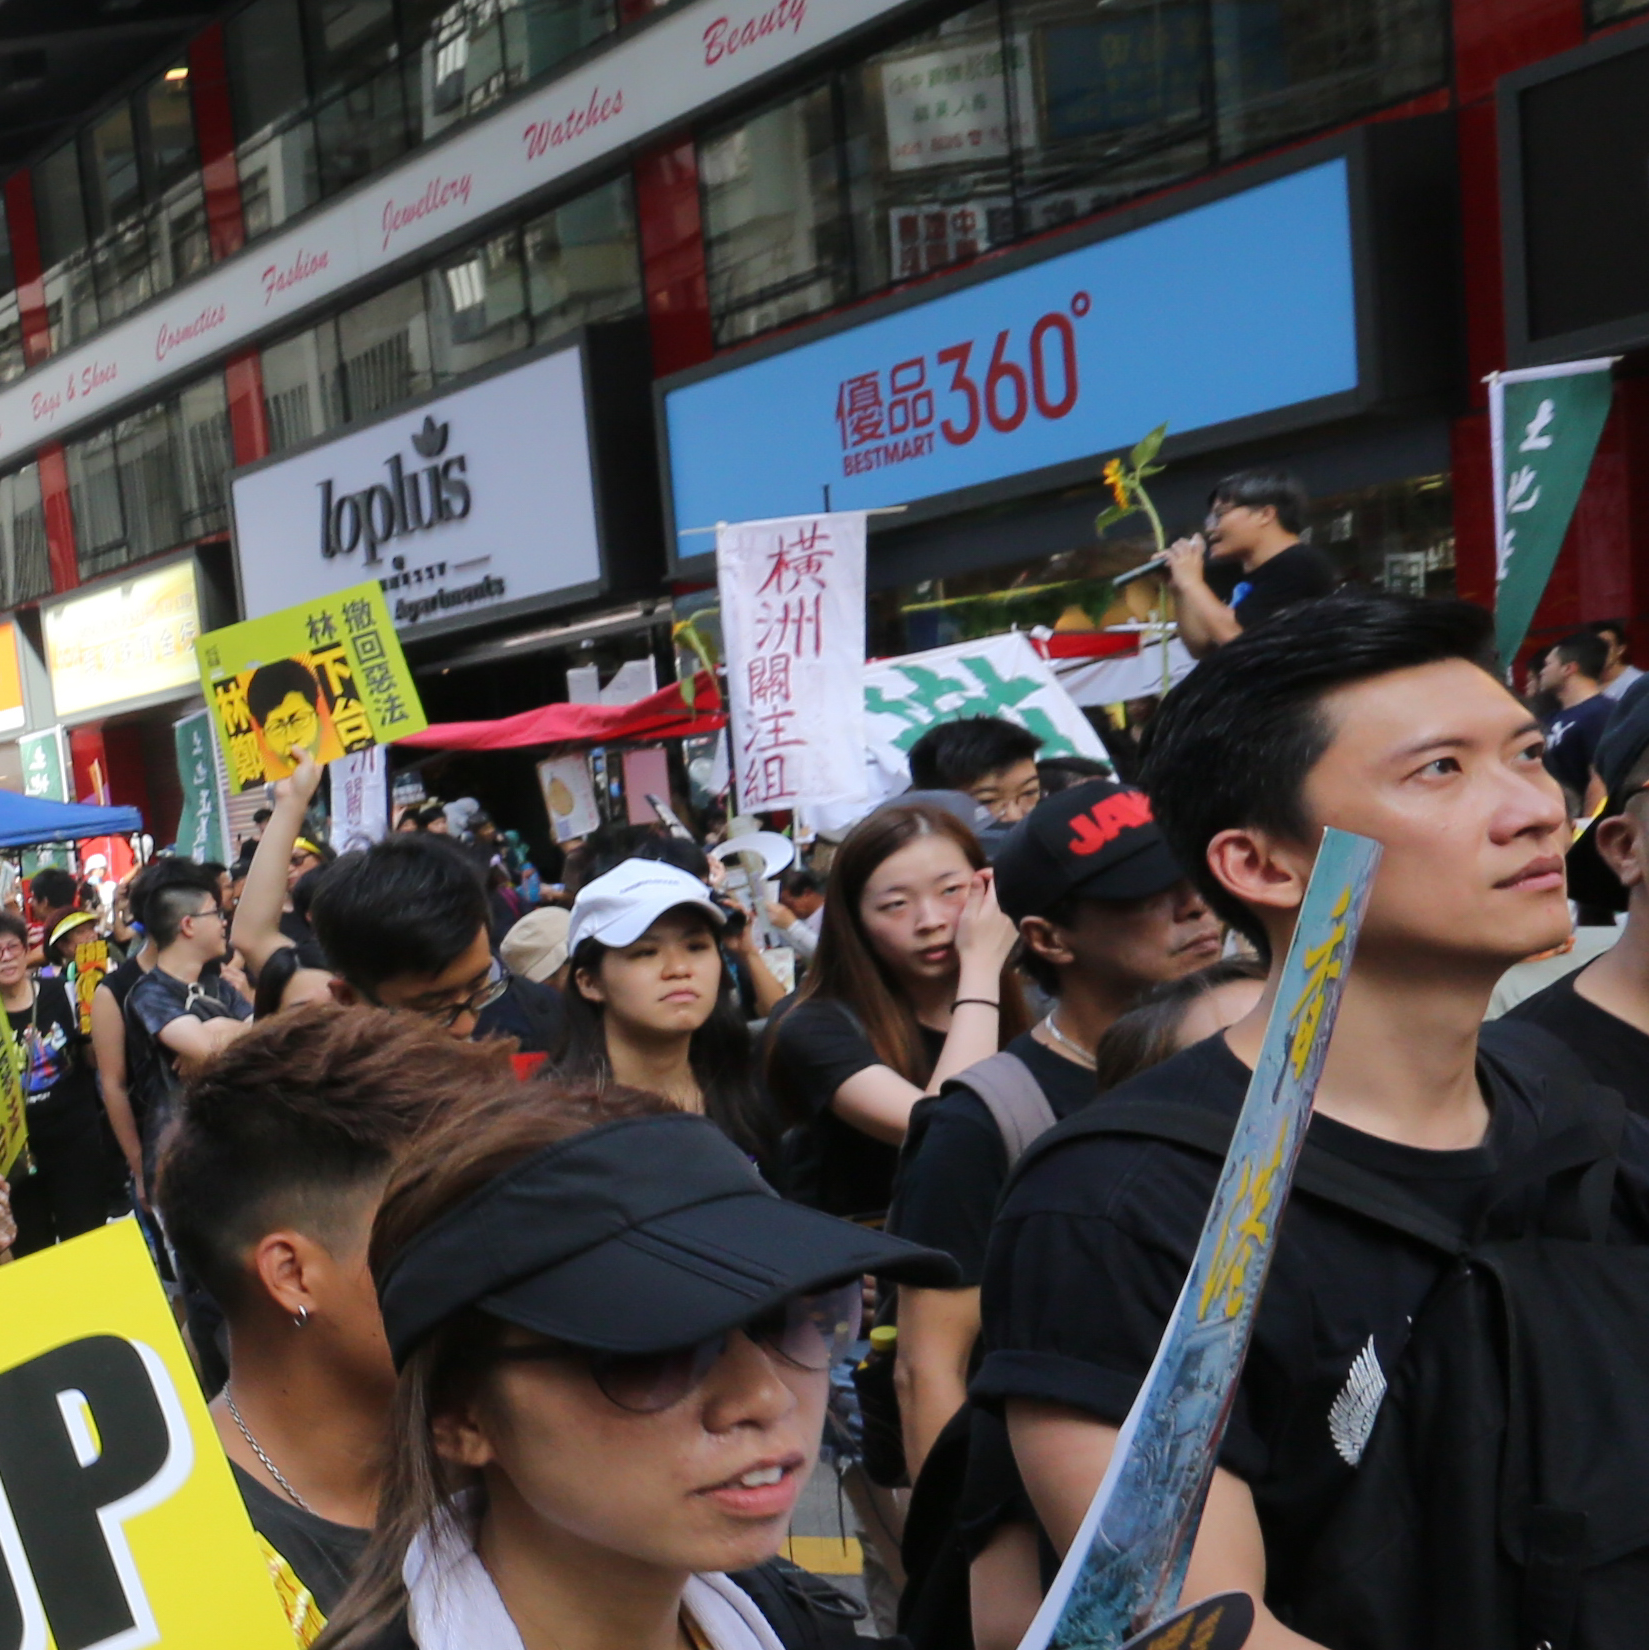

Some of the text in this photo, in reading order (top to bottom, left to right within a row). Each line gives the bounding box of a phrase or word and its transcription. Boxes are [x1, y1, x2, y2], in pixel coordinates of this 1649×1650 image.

[524, 88, 625, 160] Watches
[380, 172, 472, 251] Jewellery
[261, 250, 331, 303] Fashion
[156, 304, 227, 361] Cosmetics
[835, 355, 935, 451] 優品
[843, 432, 935, 478] BESTMART
[341, 597, 410, 727] 撤回惡法
[743, 521, 836, 806] 橫洲關注組
